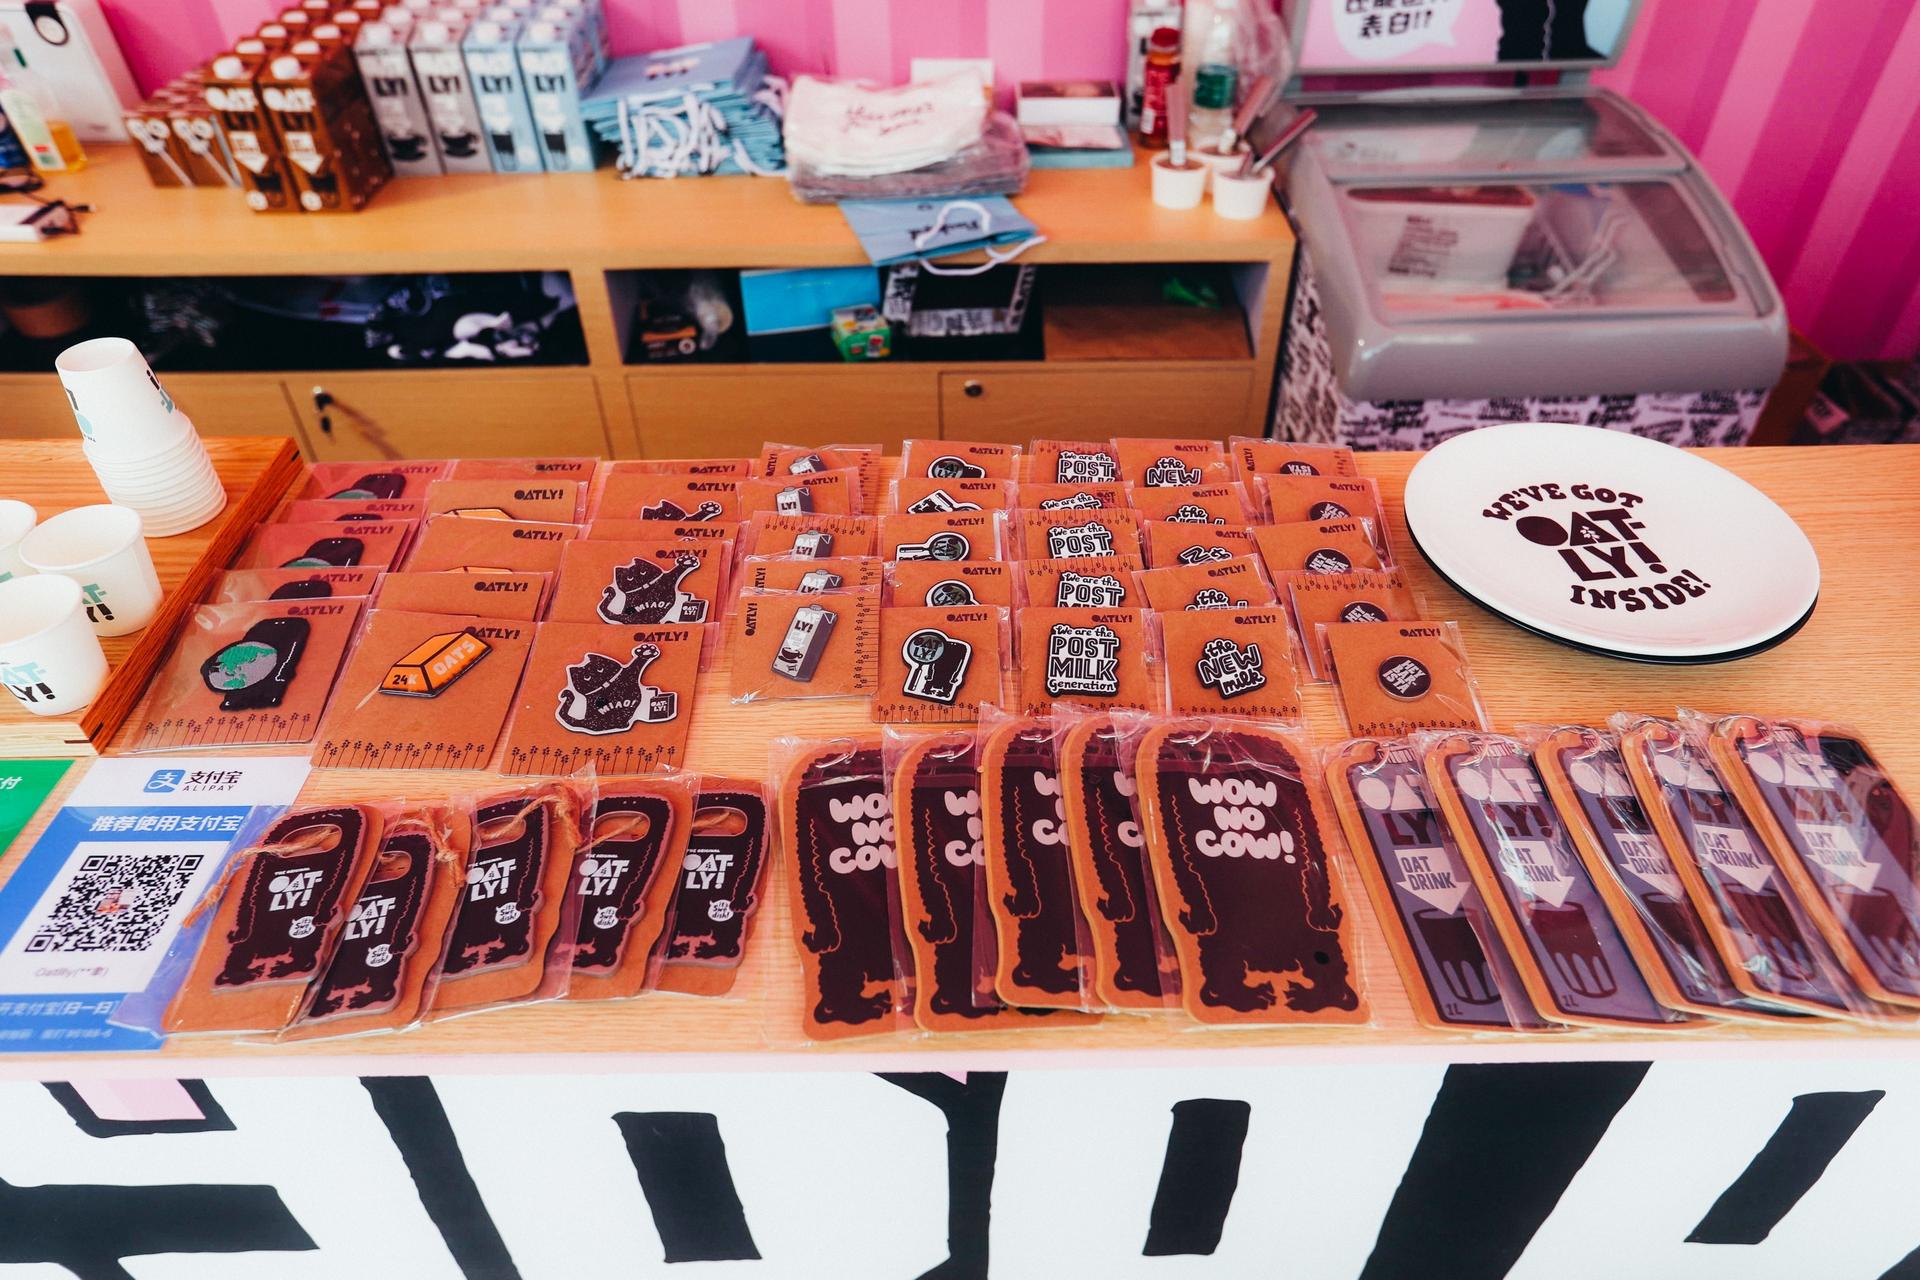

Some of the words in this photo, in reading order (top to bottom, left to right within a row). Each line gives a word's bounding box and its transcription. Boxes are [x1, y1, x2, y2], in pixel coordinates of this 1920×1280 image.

[1060, 459, 1114, 477] POST
[1159, 456, 1184, 469] the
[1148, 468, 1200, 484] NEW
[513, 489, 564, 500] OATLY!
[687, 481, 736, 492] OATLY!
[1482, 483, 1567, 521] WE'VE
[1571, 484, 1643, 508] GOT
[1179, 505, 1207, 519] the
[342, 525, 394, 535] OATLY!
[947, 517, 984, 527] OATLY!
[1319, 523, 1356, 534] OATLY!
[512, 528, 563, 541] OATLY!
[674, 527, 725, 538] OATLY!
[1052, 532, 1110, 555] POST
[1557, 542, 1668, 582] LY!
[962, 567, 1002, 576] OATLY!
[1207, 564, 1246, 577] OATLY!
[474, 581, 529, 592] OATLY!
[1060, 582, 1122, 606] POST
[1570, 569, 1711, 612] INSIDE!
[1198, 589, 1228, 604] the
[287, 605, 344, 616] OATLY!
[634, 601, 670, 613] MIAO!
[745, 602, 758, 637] OATLY!
[946, 613, 988, 622] OATLY!
[1091, 614, 1133, 623] OATLY!
[1234, 614, 1276, 625] OATLY!
[794, 620, 814, 633] LY!
[1056, 626, 1073, 635] We
[1074, 628, 1092, 636] are
[1094, 626, 1112, 638] the
[633, 631, 689, 642] OATLY!
[1051, 635, 1118, 659] POST
[1206, 640, 1236, 656] the
[432, 641, 476, 676] OATS
[1199, 646, 1260, 684] NEW
[1049, 656, 1116, 681] MILK
[1401, 659, 1427, 679] HEY
[392, 674, 417, 685] 24K
[1048, 679, 1114, 691] Generation
[1222, 670, 1266, 696] milk
[598, 699, 636, 715] MIAO!
[185, 770, 243, 785] 支付宝
[182, 784, 235, 792] ALIPAY
[1188, 777, 1278, 808] WOW
[89, 815, 243, 832] 推荐使用支付宝
[1213, 806, 1266, 832] NO
[1382, 810, 1432, 846] LY
[1195, 829, 1297, 864] COW!
[1401, 855, 1431, 874] OAT
[1710, 848, 1760, 870] DRINK
[577, 877, 619, 896] LY!
[685, 871, 725, 890] LY!
[1406, 872, 1457, 891] DRINK
[471, 876, 509, 902] LY!
[268, 888, 313, 912] LY!
[344, 916, 387, 941] LY!
